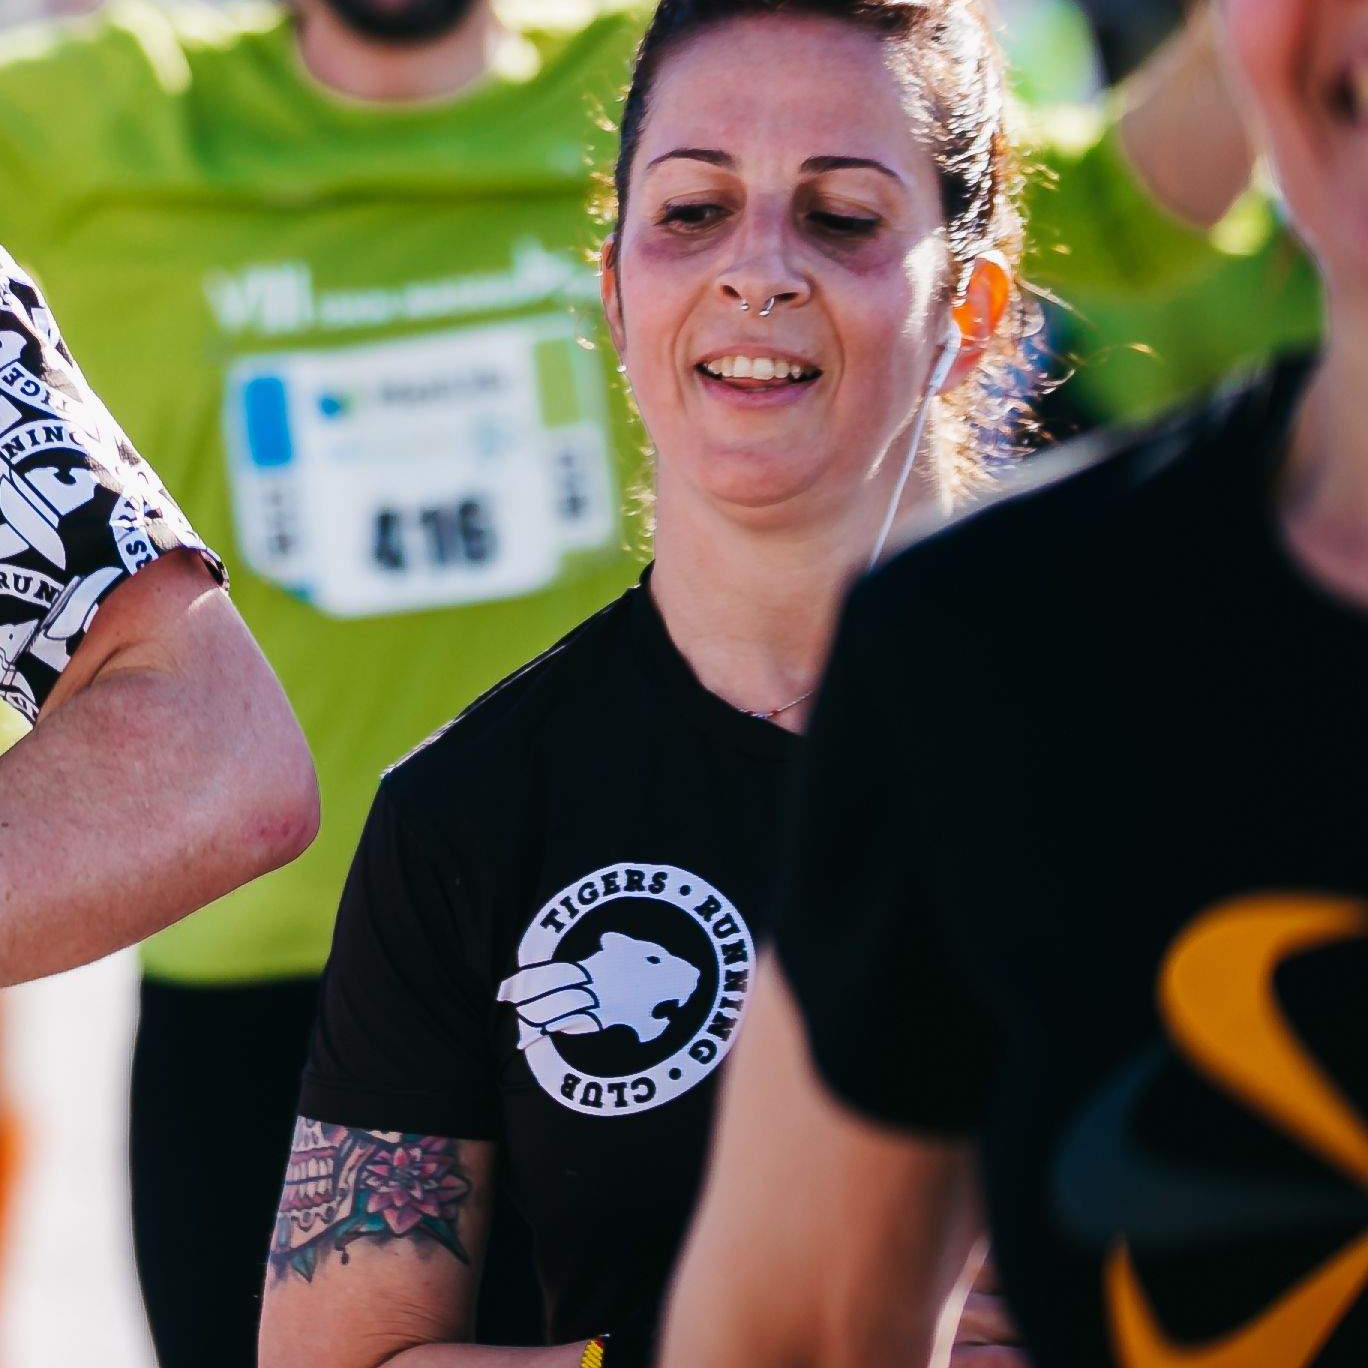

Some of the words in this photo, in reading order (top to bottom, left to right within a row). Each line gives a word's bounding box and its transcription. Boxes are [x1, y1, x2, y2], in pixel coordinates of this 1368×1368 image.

[540, 868, 669, 934] TIGERS
[688, 894, 748, 1065] RUNNING
[560, 1073, 657, 1109] CLUB
